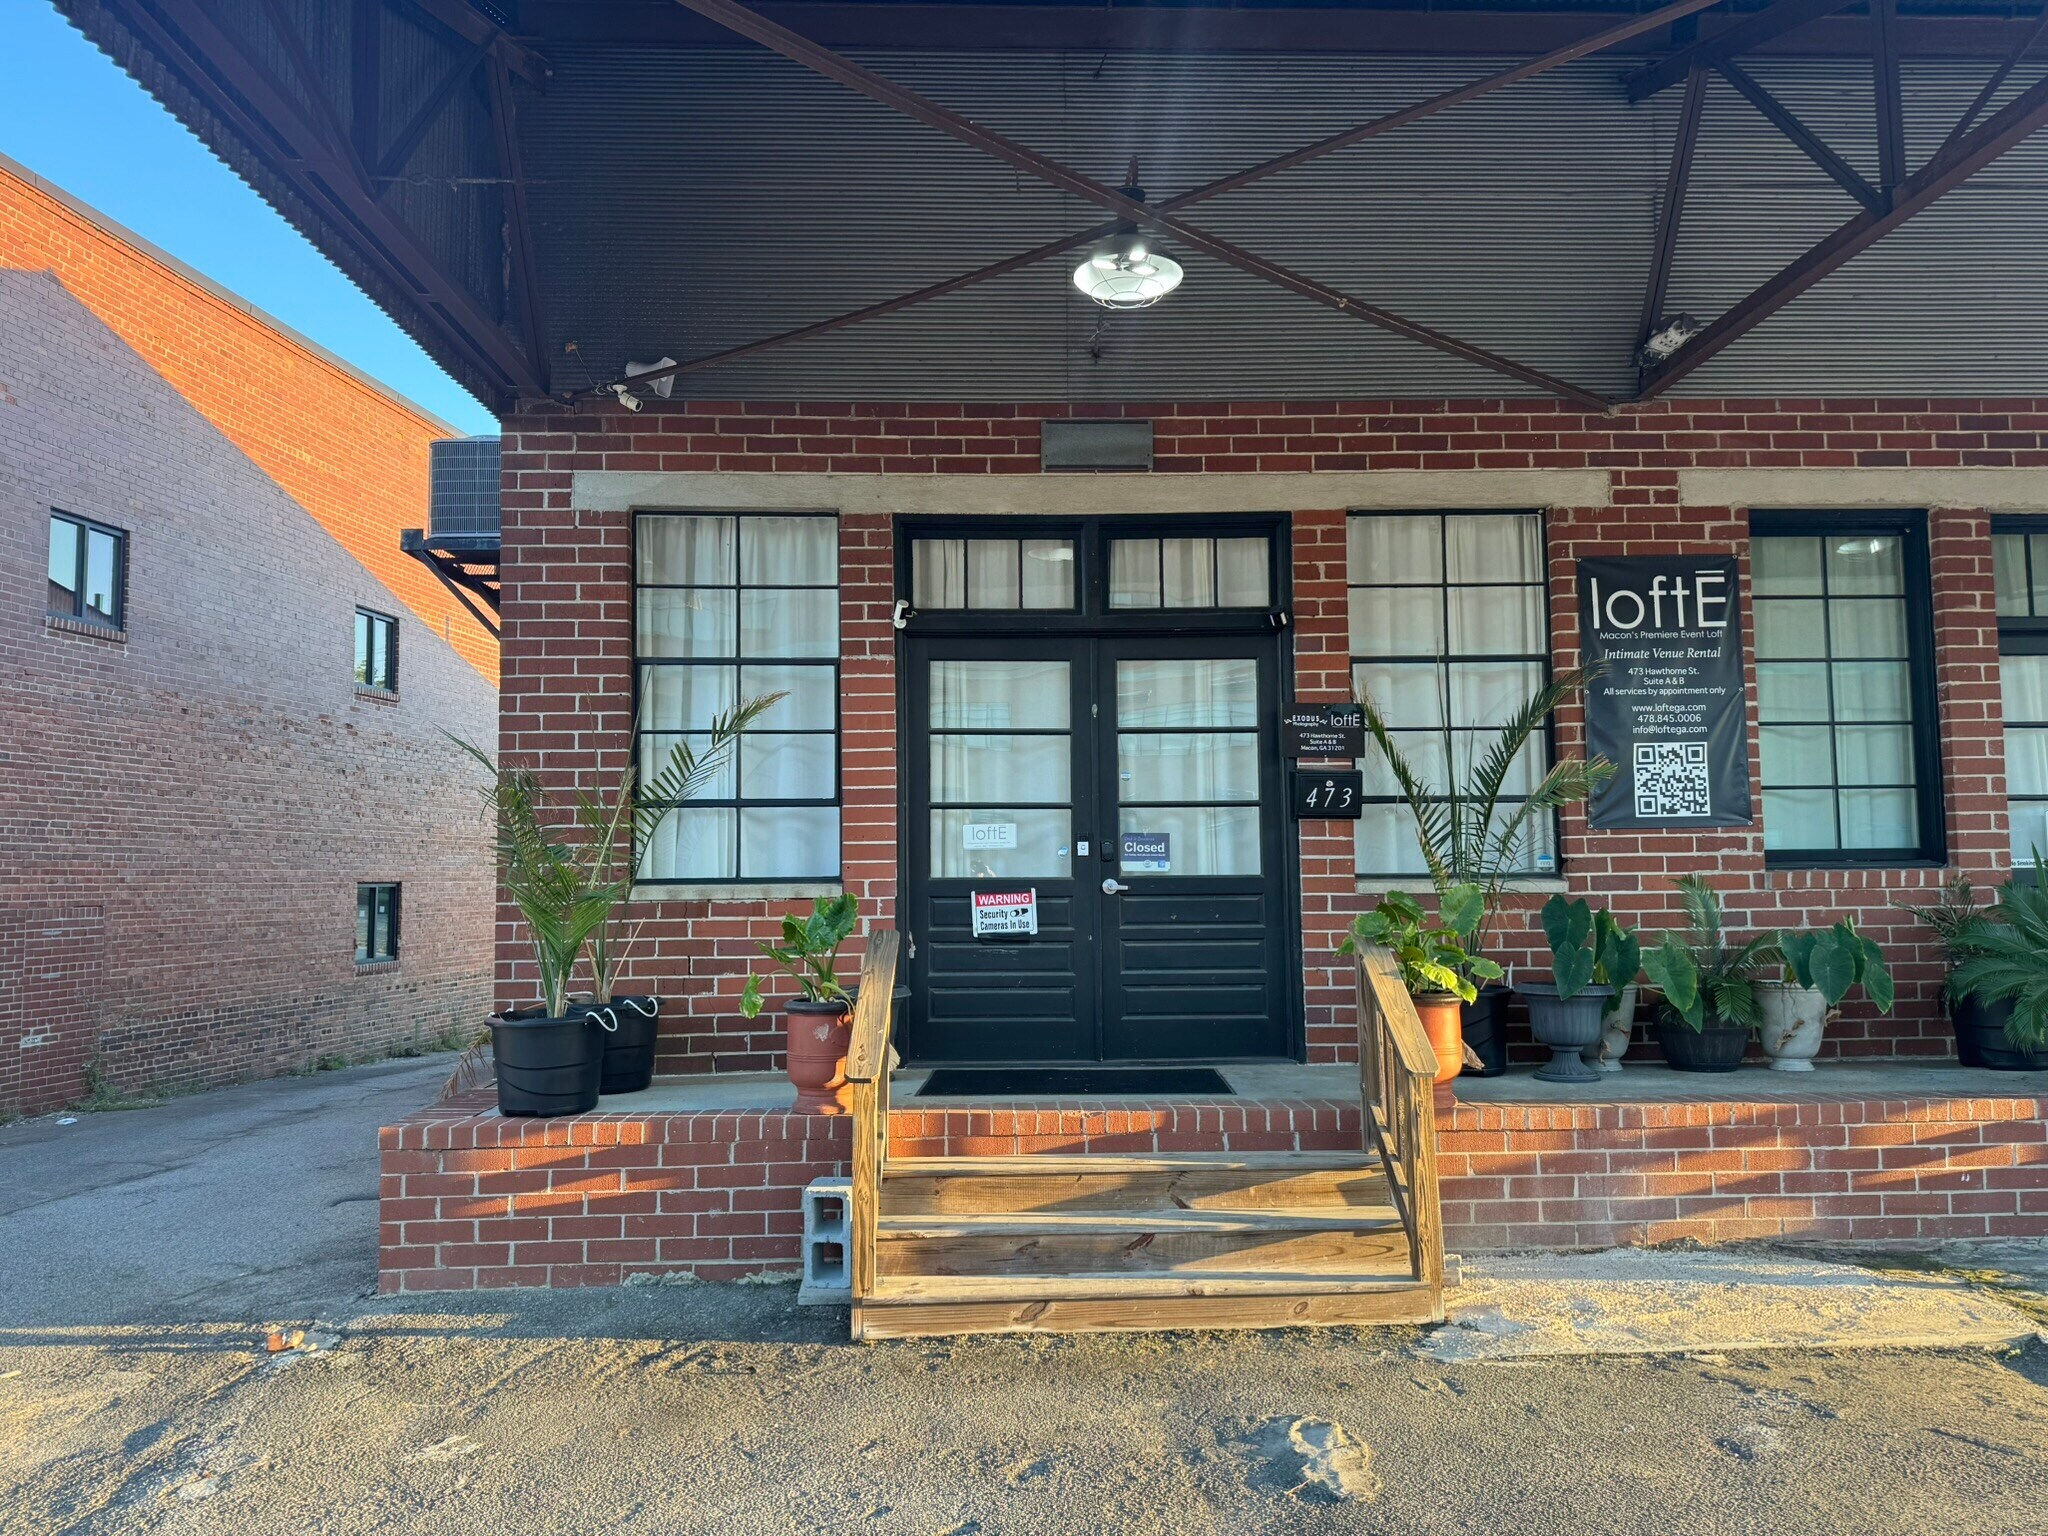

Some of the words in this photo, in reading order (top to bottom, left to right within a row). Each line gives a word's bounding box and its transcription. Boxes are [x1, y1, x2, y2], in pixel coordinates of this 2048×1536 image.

[1600, 631, 1639, 640] Macon's
[1640, 631, 1678, 639] Premiere
[1681, 630, 1705, 638] Event
[1707, 629, 1723, 638] Loft
[1604, 648, 1650, 659] Intimate
[1652, 647, 1684, 659] Venue
[1687, 646, 1721, 658] Rental
[1628, 667, 1644, 675] 473
[1645, 667, 1687, 675] Hawthorne
[1688, 667, 1700, 675] St.
[1643, 677, 1664, 685] Suite
[1665, 677, 1671, 685] A
[1671, 677, 1678, 685] &
[1603, 687, 1614, 696] All
[1615, 688, 1647, 696] services
[1648, 687, 1659, 697] by
[1659, 687, 1708, 697] appointment
[1709, 686, 1726, 696] only
[1631, 703, 1707, 714] www.loftega.com
[1292, 714, 1320, 722] EXODUS
[1637, 714, 1702, 723] 478.845.0006
[1632, 725, 1708, 735] info@loftega.com
[1306, 787, 1352, 808] 473
[1124, 841, 1165, 853] Closed
[978, 893, 1030, 906] WARNING
[979, 909, 1008, 920] Security
[980, 921, 1009, 931] Cameras
[1010, 920, 1017, 930] In
[1018, 919, 1030, 929] Use
